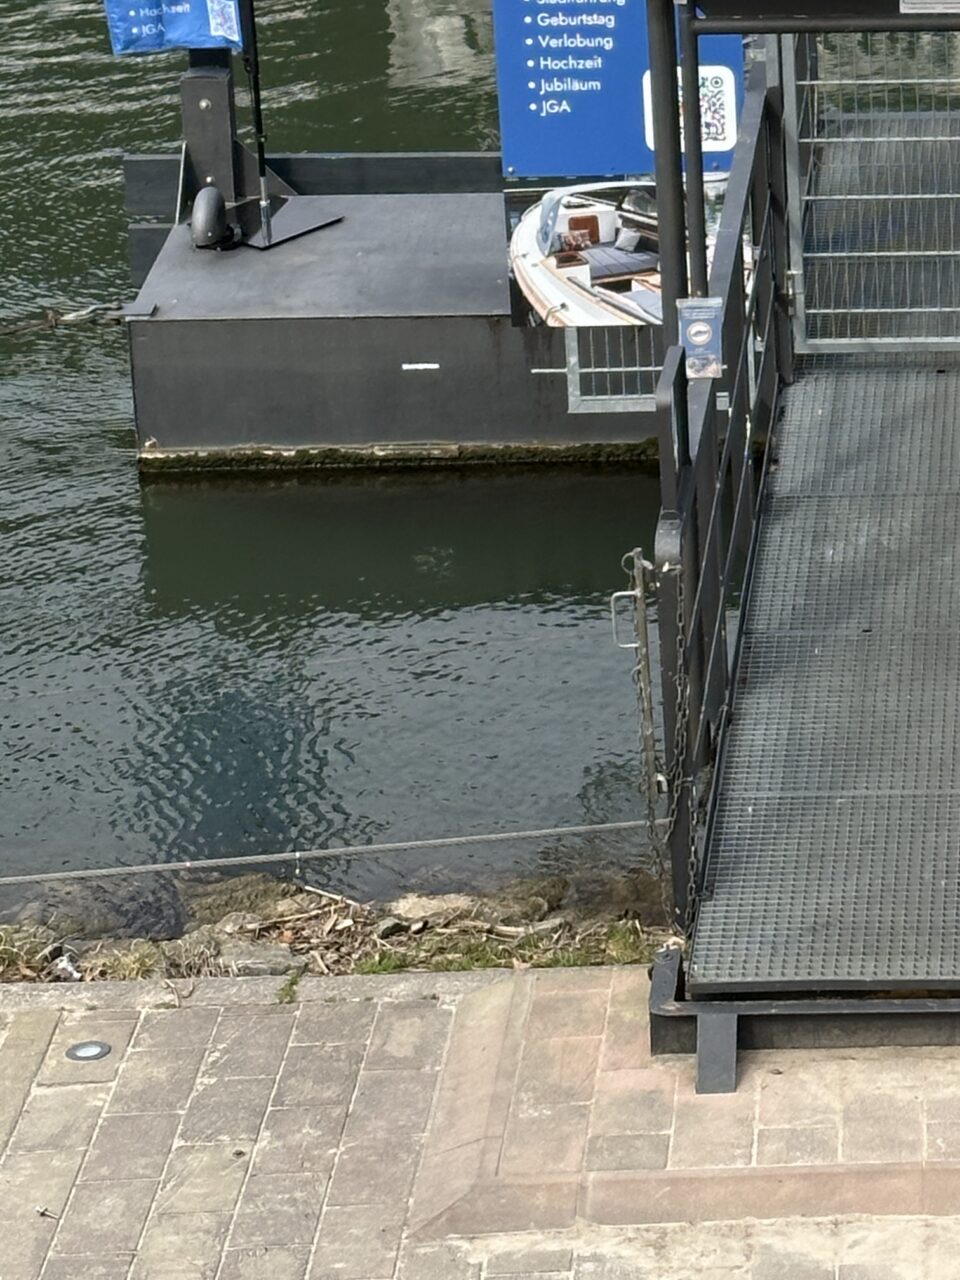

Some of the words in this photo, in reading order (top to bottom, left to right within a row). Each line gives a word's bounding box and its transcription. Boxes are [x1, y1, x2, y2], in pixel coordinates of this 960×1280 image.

[140, 2, 190, 16] Hochzeit
[537, 13, 615, 28] Geburtstag
[538, 34, 613, 50] Verlobung
[540, 55, 602, 69] Hochzeit
[540, 78, 601, 95] Jubiläum
[540, 99, 571, 116] JGA
